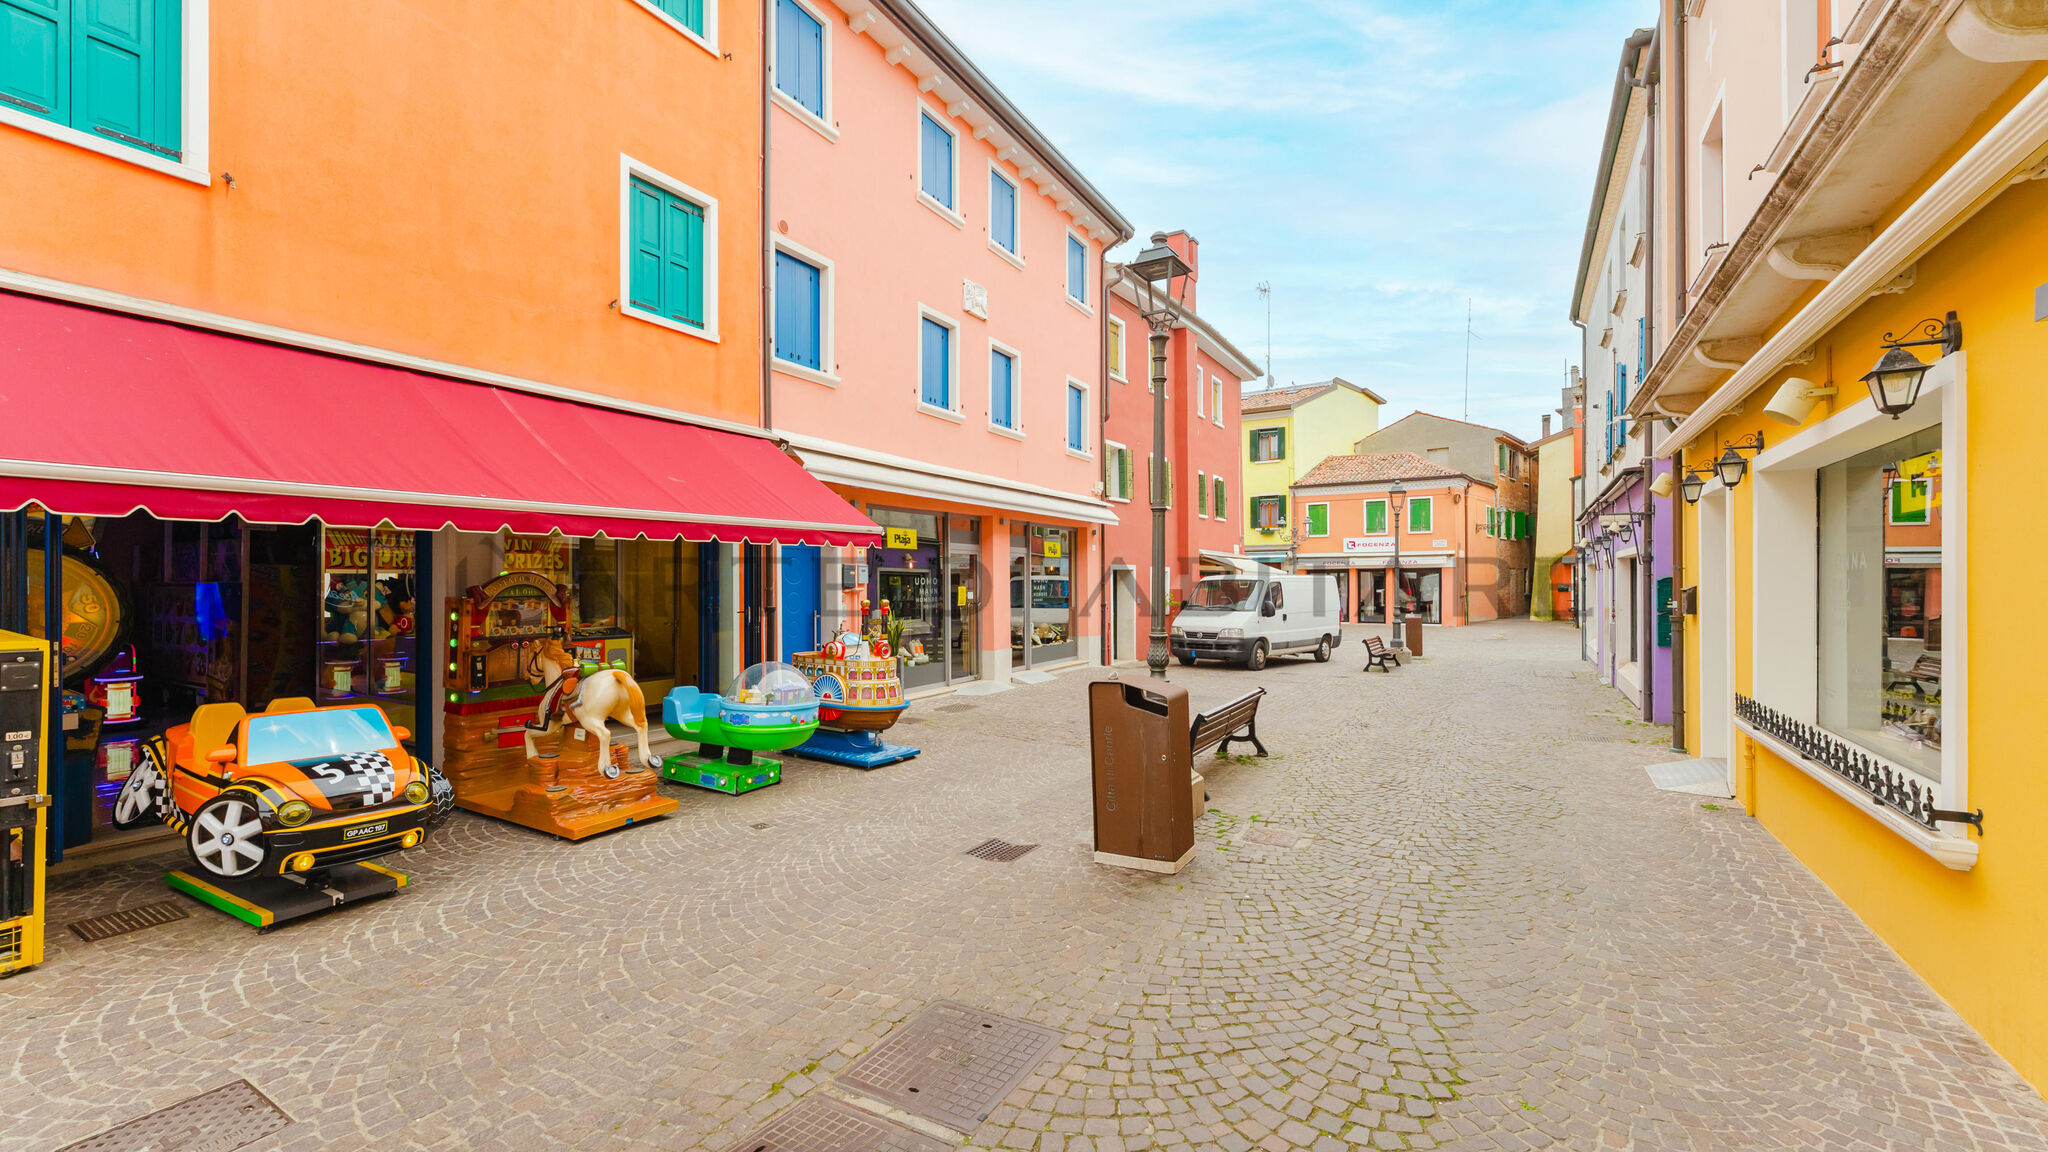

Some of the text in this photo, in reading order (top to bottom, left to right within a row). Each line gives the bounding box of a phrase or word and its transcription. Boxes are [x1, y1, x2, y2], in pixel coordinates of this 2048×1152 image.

[894, 533, 911, 546] Plaja
[328, 547, 367, 568] BIG
[504, 553, 564, 570] PRIZES
[311, 762, 346, 785] 5
